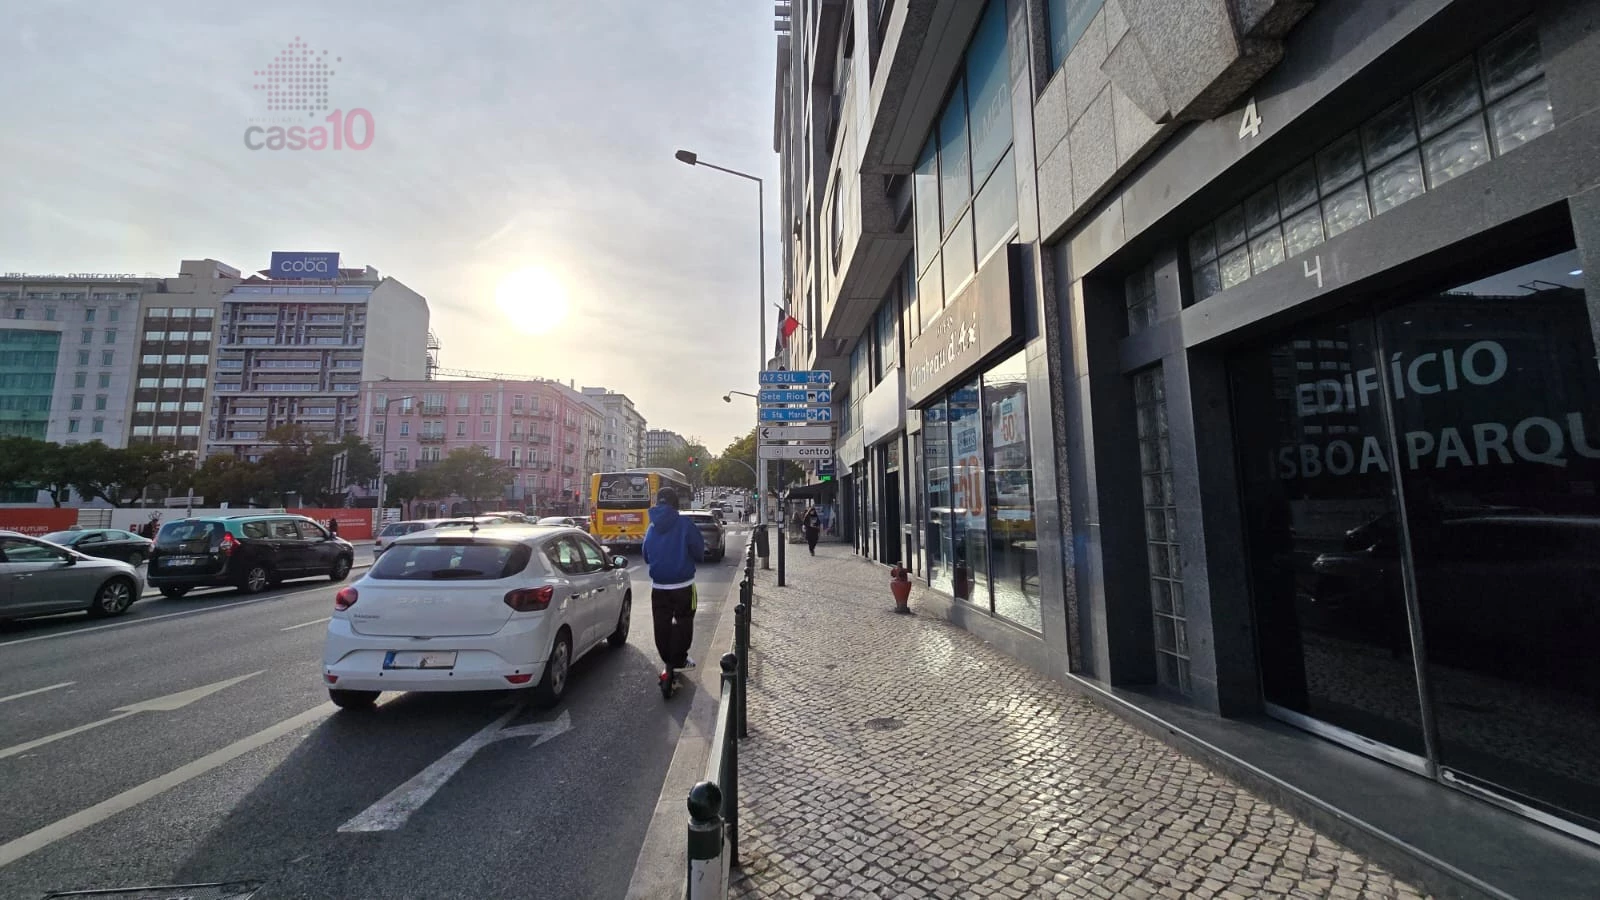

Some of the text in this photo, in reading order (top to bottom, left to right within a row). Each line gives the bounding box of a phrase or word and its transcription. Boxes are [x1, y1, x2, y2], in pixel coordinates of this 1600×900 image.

[1238, 97, 1262, 139] 4
[281, 257, 328, 272] coba
[1303, 255, 1323, 288] 4
[761, 373, 796, 382] A2 SUL
[1296, 339, 1508, 417] EDIFÍCIO
[761, 392, 805, 400] Sete Rios
[788, 410, 807, 418] Maria
